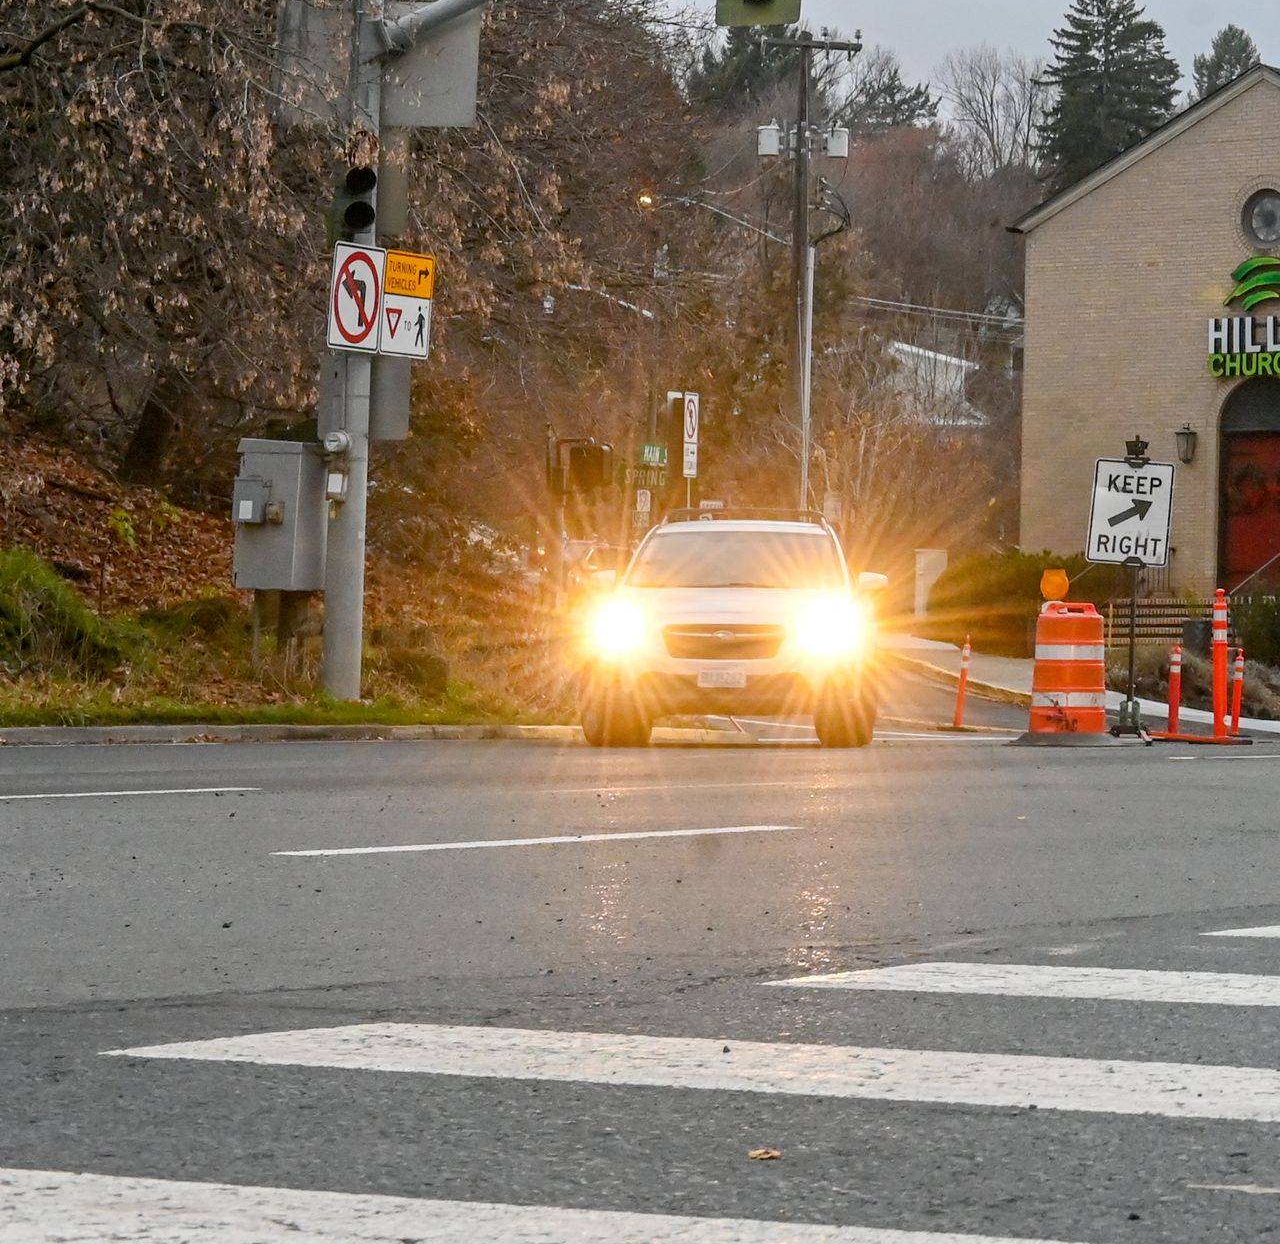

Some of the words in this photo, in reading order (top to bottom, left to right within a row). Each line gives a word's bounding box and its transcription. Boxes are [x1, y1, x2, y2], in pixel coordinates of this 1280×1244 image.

[389, 260, 417, 275] TURNING
[387, 276, 417, 291] VEHICLES
[404, 320, 411, 332] TO
[643, 445, 661, 463] MAIN
[624, 468, 666, 486] SPRING
[1107, 473, 1163, 496] KEEP
[1096, 533, 1162, 558] RIGHT
